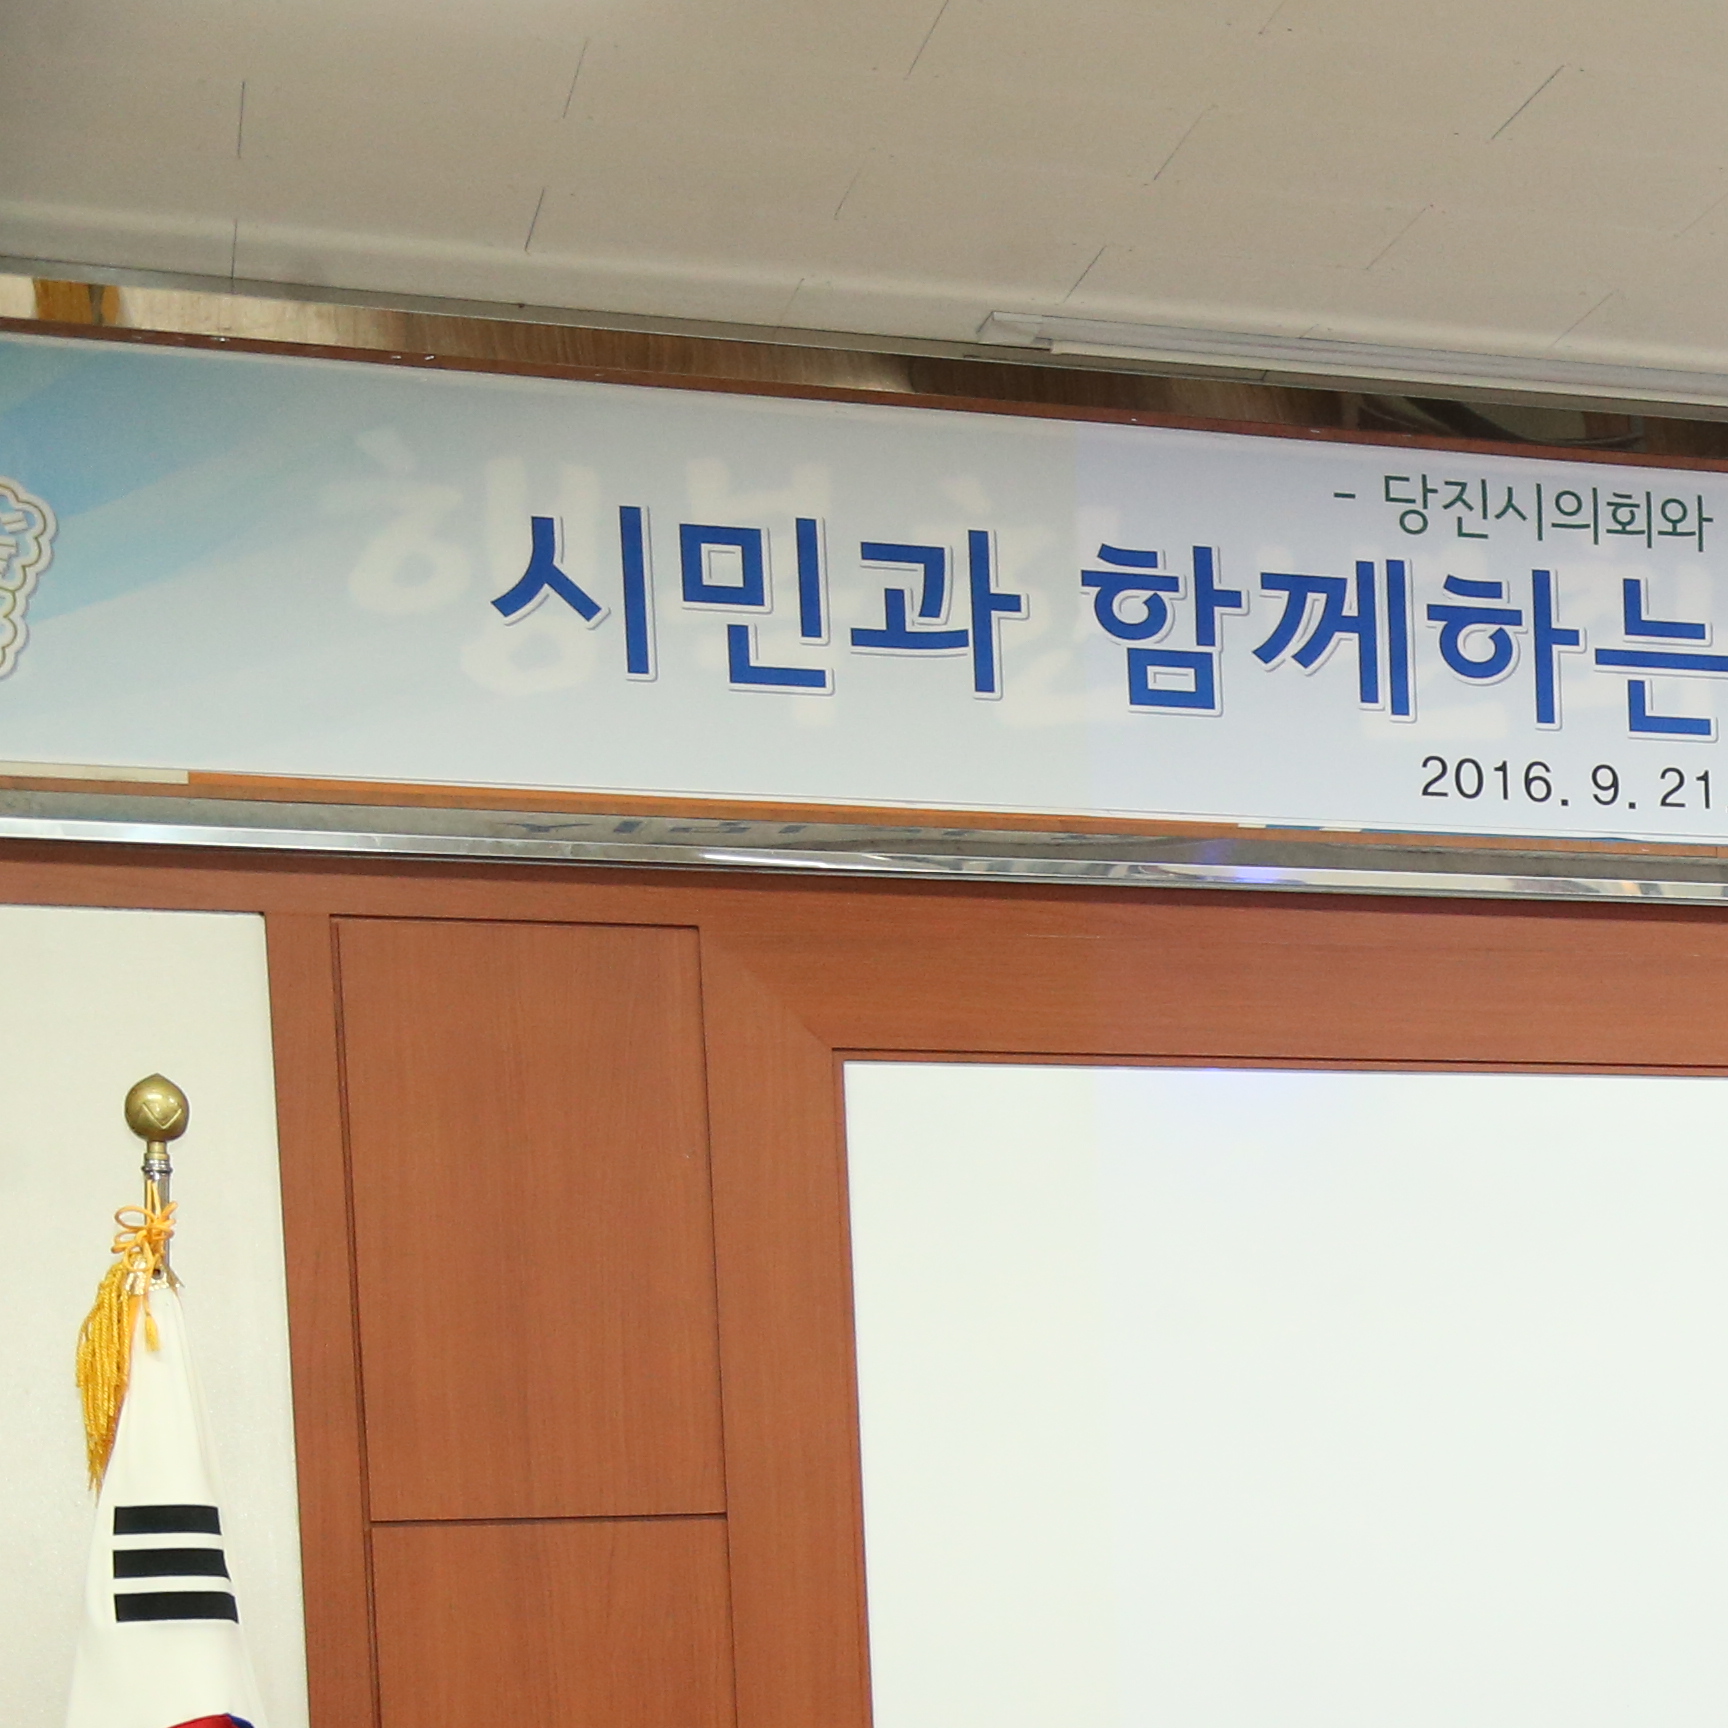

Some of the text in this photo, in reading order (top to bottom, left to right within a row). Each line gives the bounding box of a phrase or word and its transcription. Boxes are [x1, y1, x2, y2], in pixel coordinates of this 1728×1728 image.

[1382, 473, 1714, 553] 당진시의회와
[491, 506, 1021, 694] 시민과
[1420, 755, 1570, 808] 2016.
[1590, 763, 1638, 811] 9.
